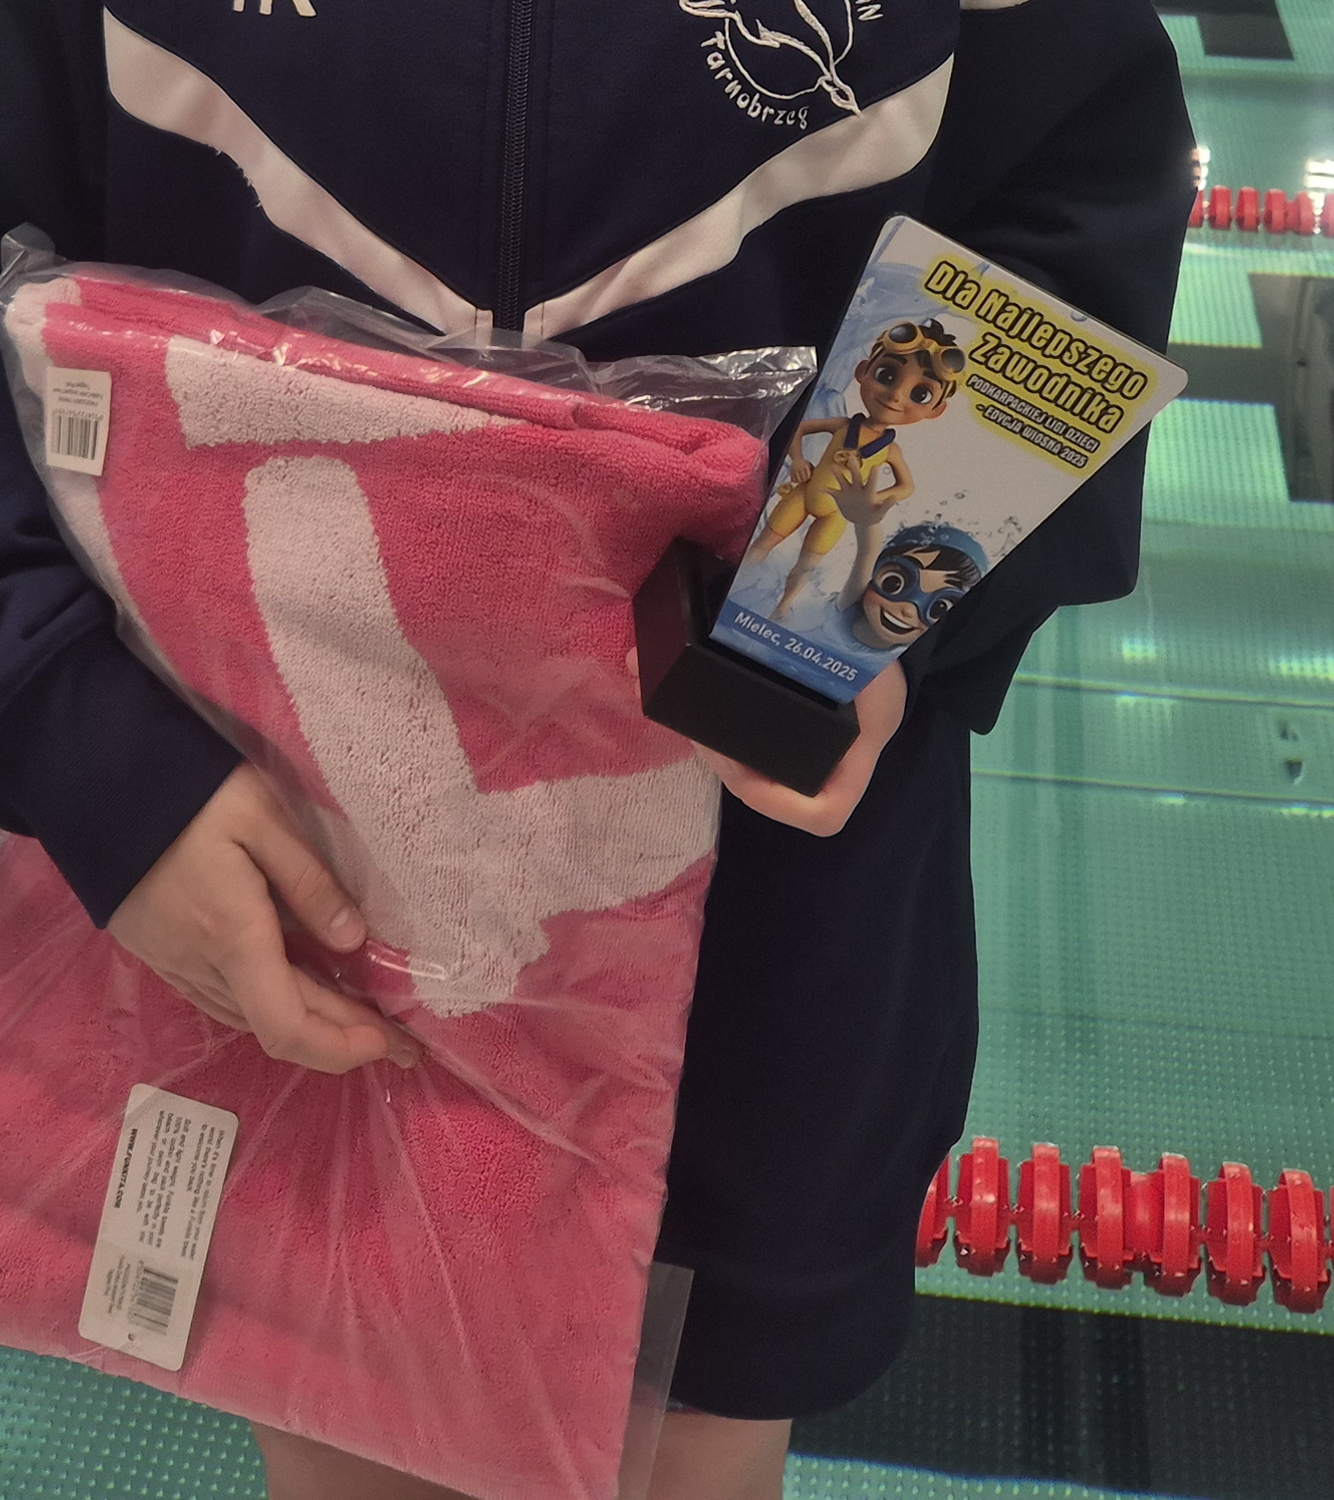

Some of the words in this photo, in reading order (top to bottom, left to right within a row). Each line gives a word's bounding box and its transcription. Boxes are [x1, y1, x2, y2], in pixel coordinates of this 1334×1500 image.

[924, 260, 981, 310] Dla
[975, 289, 1148, 400] Najlepszego
[967, 374, 1048, 424] PODKARPACKIEJ
[1046, 414, 1065, 436] LIGI
[1066, 425, 1100, 452] DZIECI
[968, 332, 1124, 433] Zawodnika
[984, 406, 1021, 436] EDYCJA
[1022, 426, 1061, 455] WIOSNA
[1059, 447, 1088, 468] 2025
[734, 611, 781, 647] Mielec,
[784, 637, 859, 682] 26.04.2025
